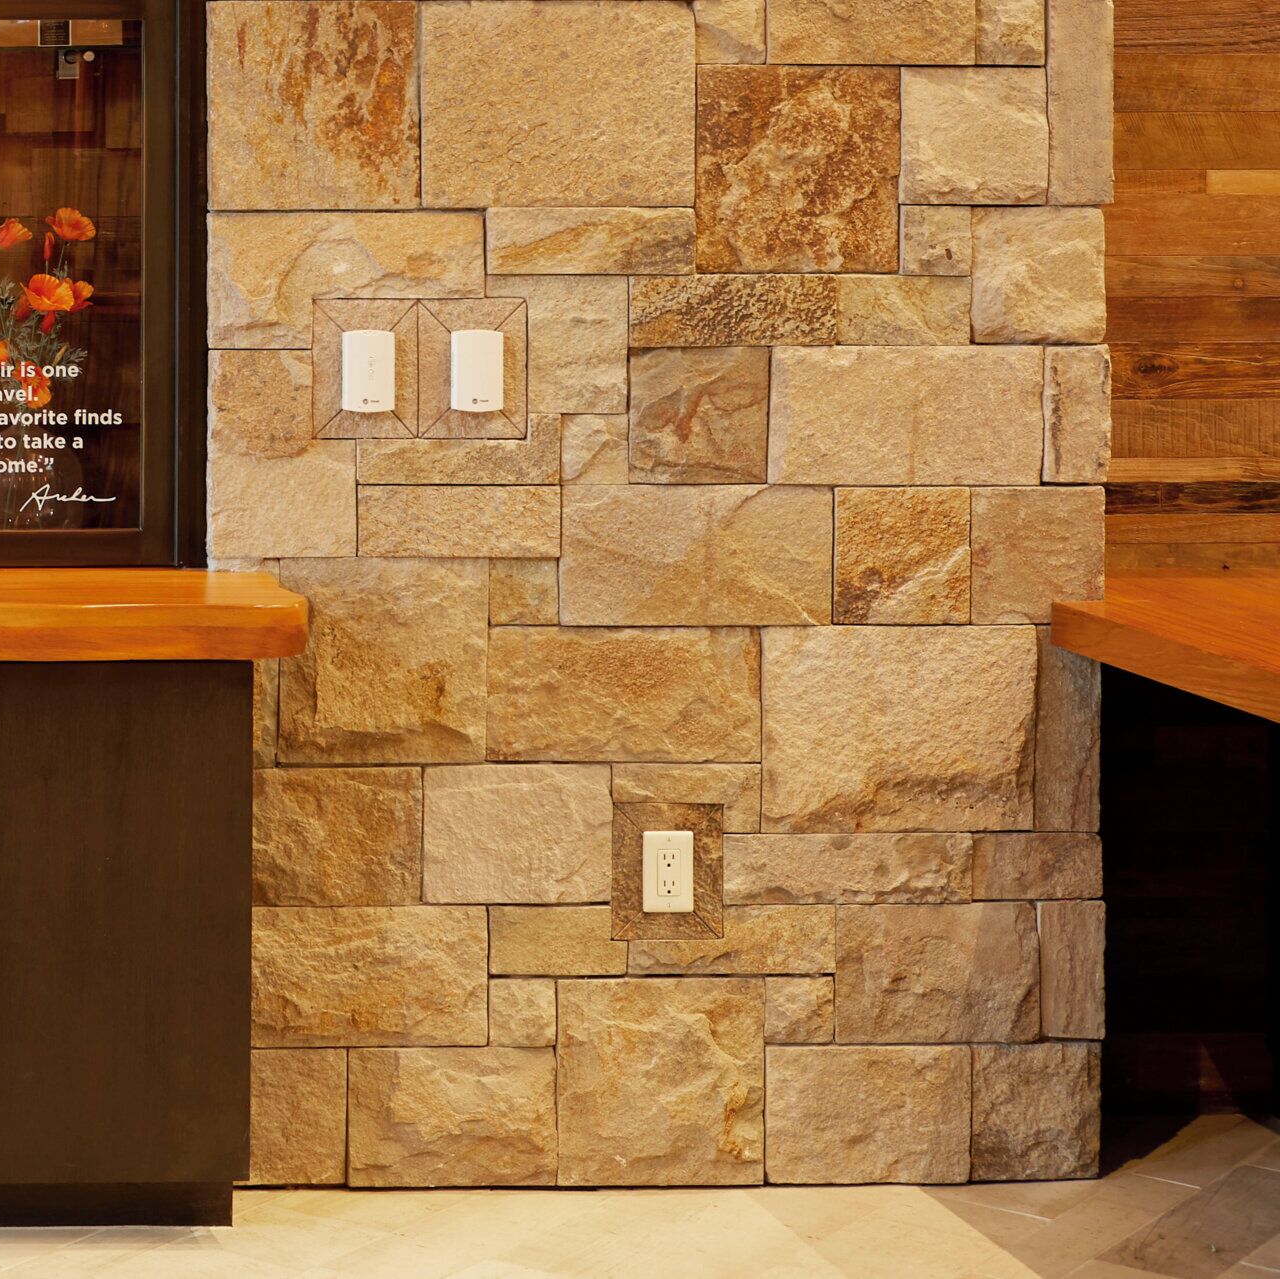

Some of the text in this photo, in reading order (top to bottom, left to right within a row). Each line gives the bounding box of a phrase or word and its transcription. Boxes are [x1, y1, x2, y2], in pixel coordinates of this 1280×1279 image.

[21, 362, 36, 378] is
[42, 365, 79, 378] one
[74, 409, 123, 425] finds
[23, 434, 66, 449] take
[72, 437, 84, 449] a
